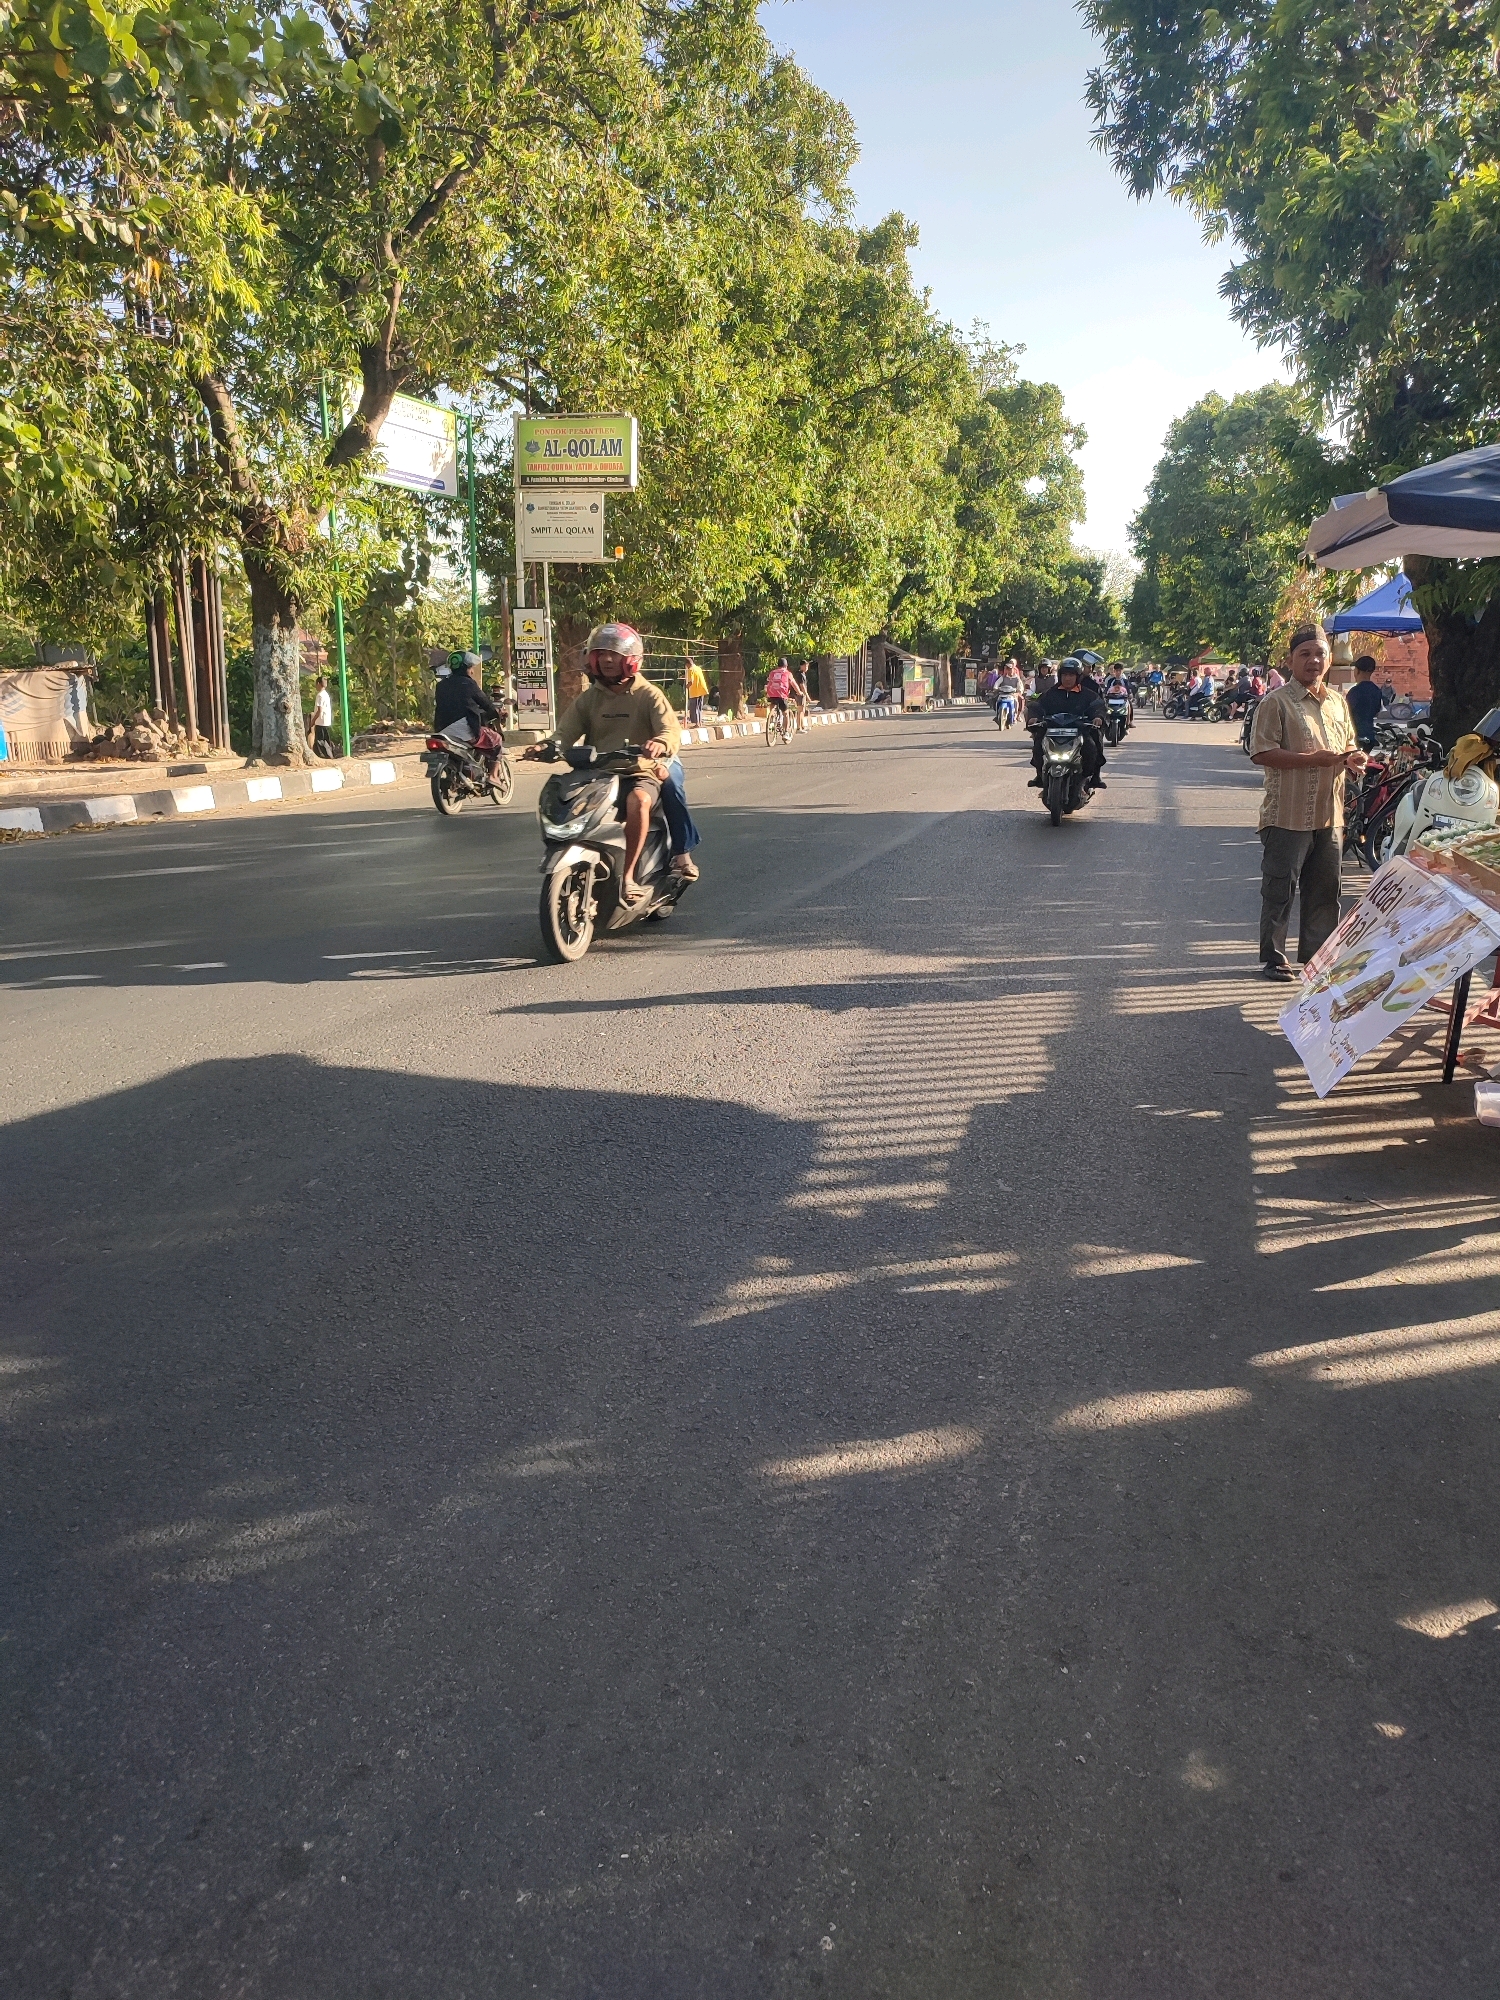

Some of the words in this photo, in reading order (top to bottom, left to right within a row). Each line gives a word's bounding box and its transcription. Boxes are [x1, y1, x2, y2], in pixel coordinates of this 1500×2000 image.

[534, 428, 567, 436] PONDOK
[543, 438, 623, 458] AL-QOLAM
[527, 463, 550, 471] TAHFIDZ
[575, 463, 593, 471] YATIM
[599, 463, 624, 471] DHUAFA
[530, 526, 552, 534] SMPIT
[554, 526, 563, 534] AL
[565, 526, 594, 535] QOLAM
[1366, 867, 1413, 917] Kedai
